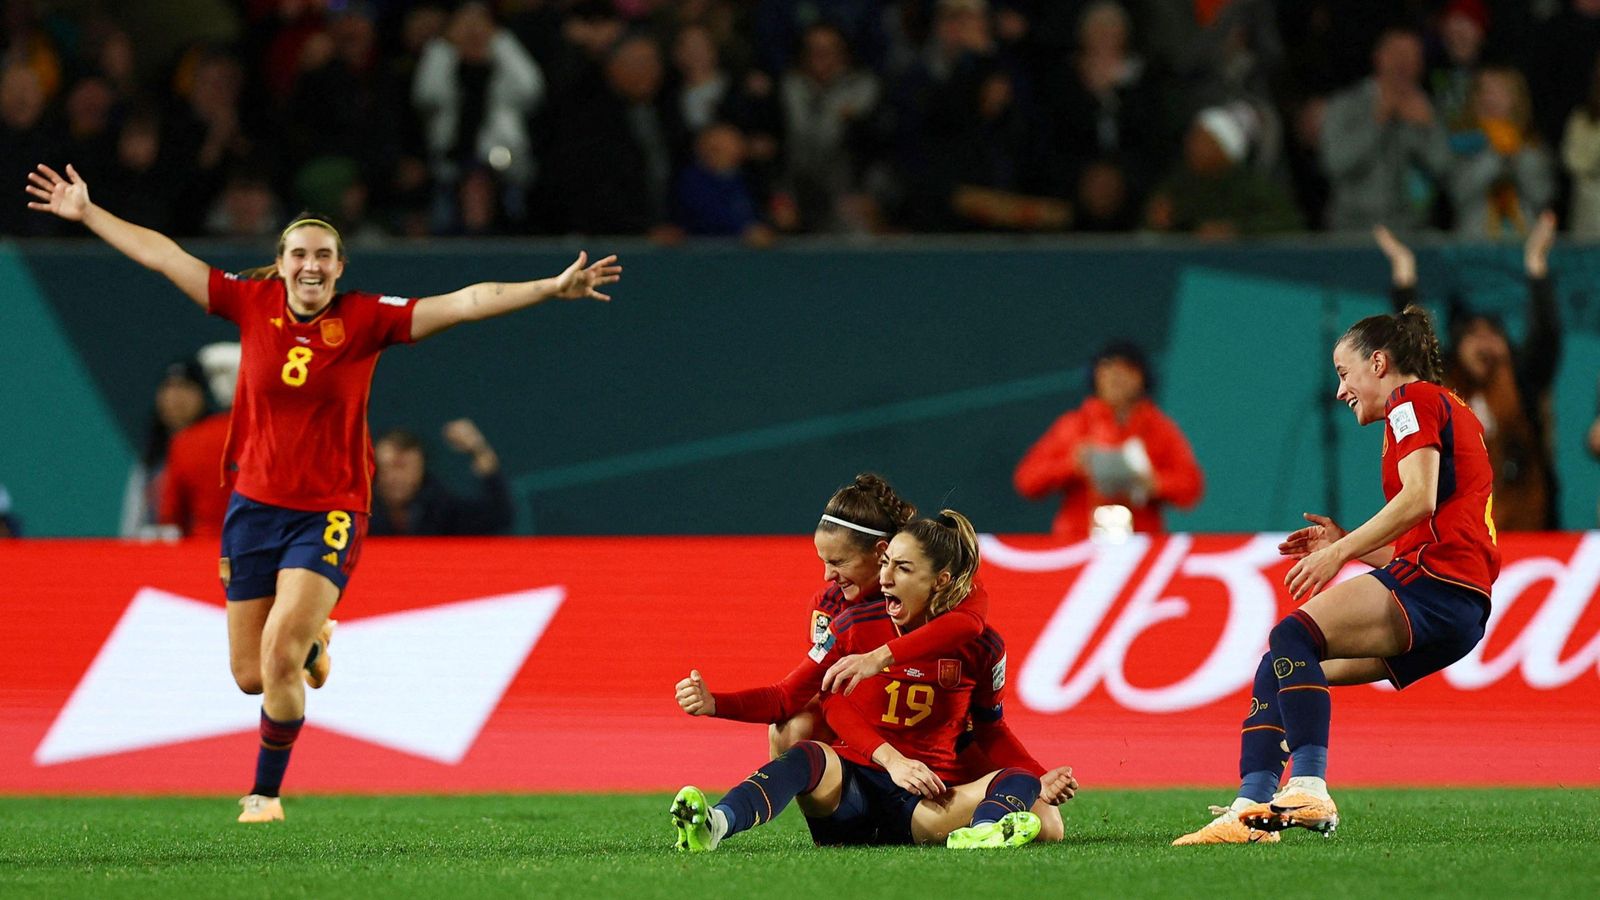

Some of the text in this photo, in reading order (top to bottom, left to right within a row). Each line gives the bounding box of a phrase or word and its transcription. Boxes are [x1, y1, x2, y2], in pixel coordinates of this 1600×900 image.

[282, 346, 314, 386] 8
[323, 510, 351, 550] 8
[979, 532, 1600, 713] Bd
[882, 680, 934, 726] 19
